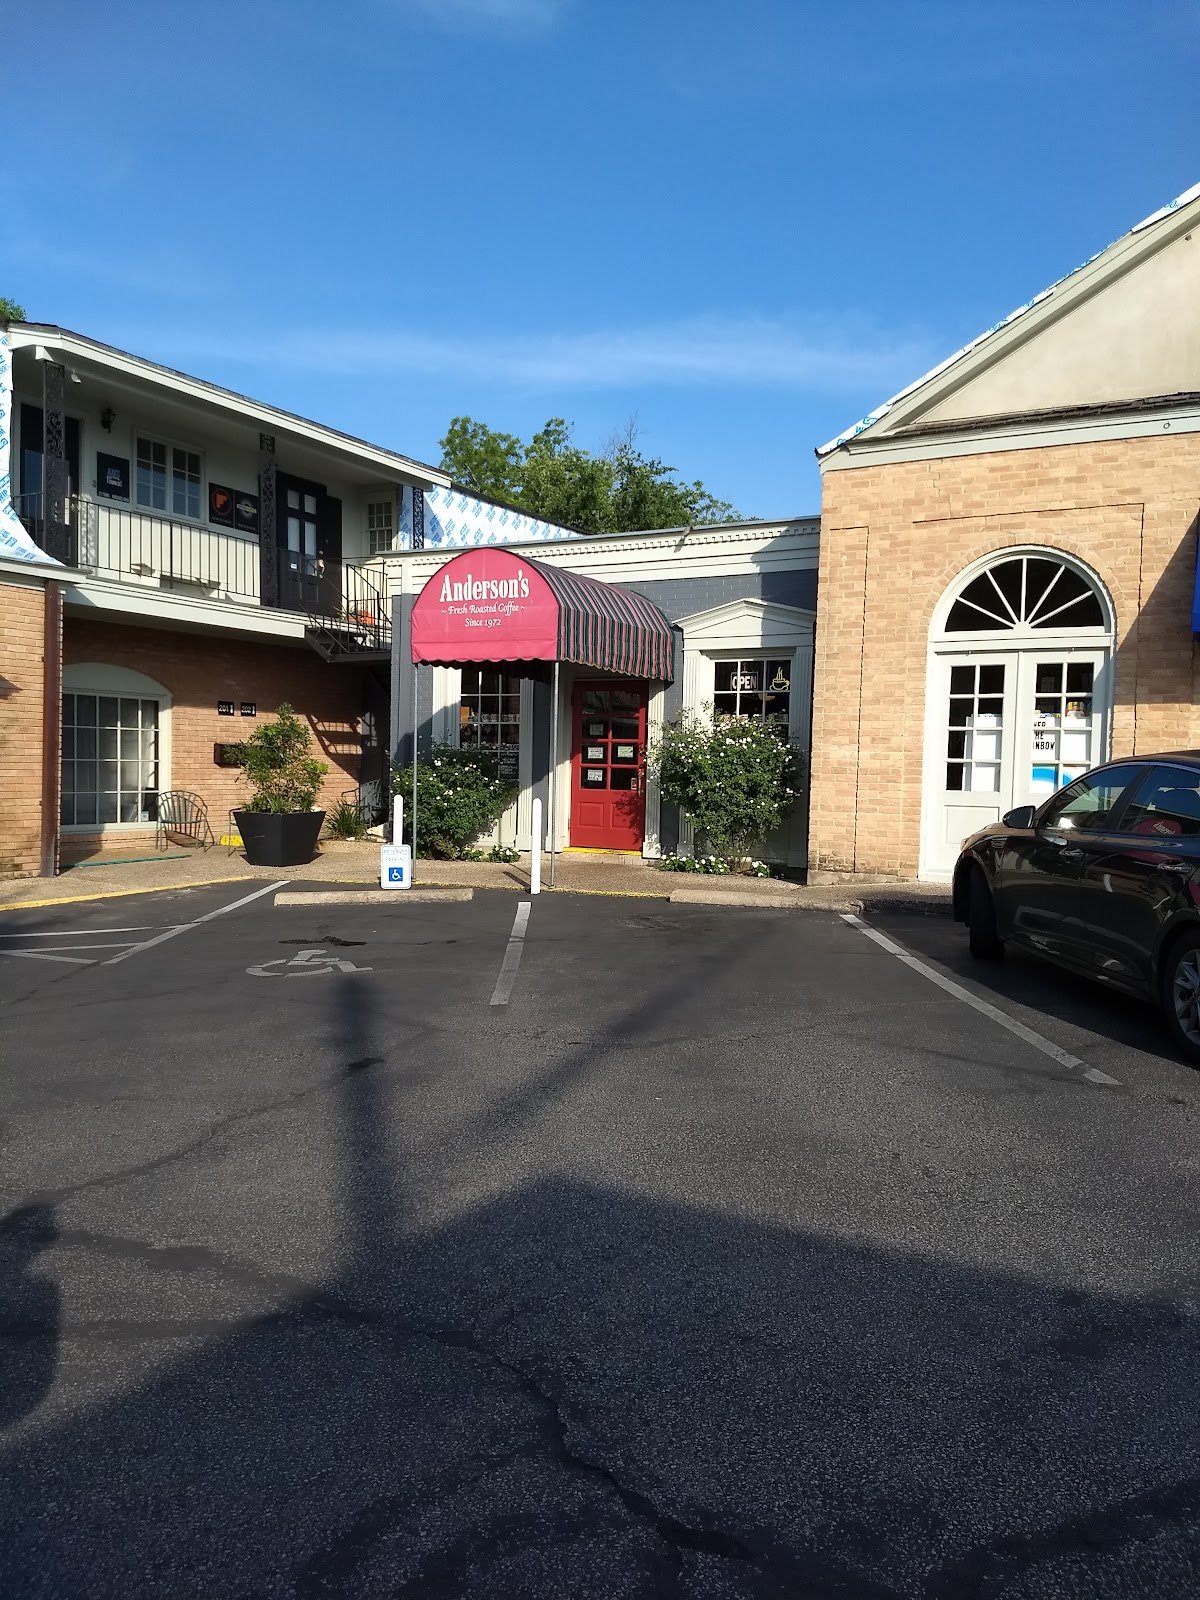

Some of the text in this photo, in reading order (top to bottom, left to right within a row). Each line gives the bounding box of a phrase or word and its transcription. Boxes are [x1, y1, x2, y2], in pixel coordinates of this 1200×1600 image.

[440, 569, 530, 602] Anderson's
[448, 600, 519, 616] Fresh Roasted Coffee
[465, 618, 501, 628] Since 1972
[732, 676, 757, 689] OPEN
[218, 704, 229, 712] 201
[241, 705, 251, 713] 202
[1033, 741, 1056, 750] INBOW
